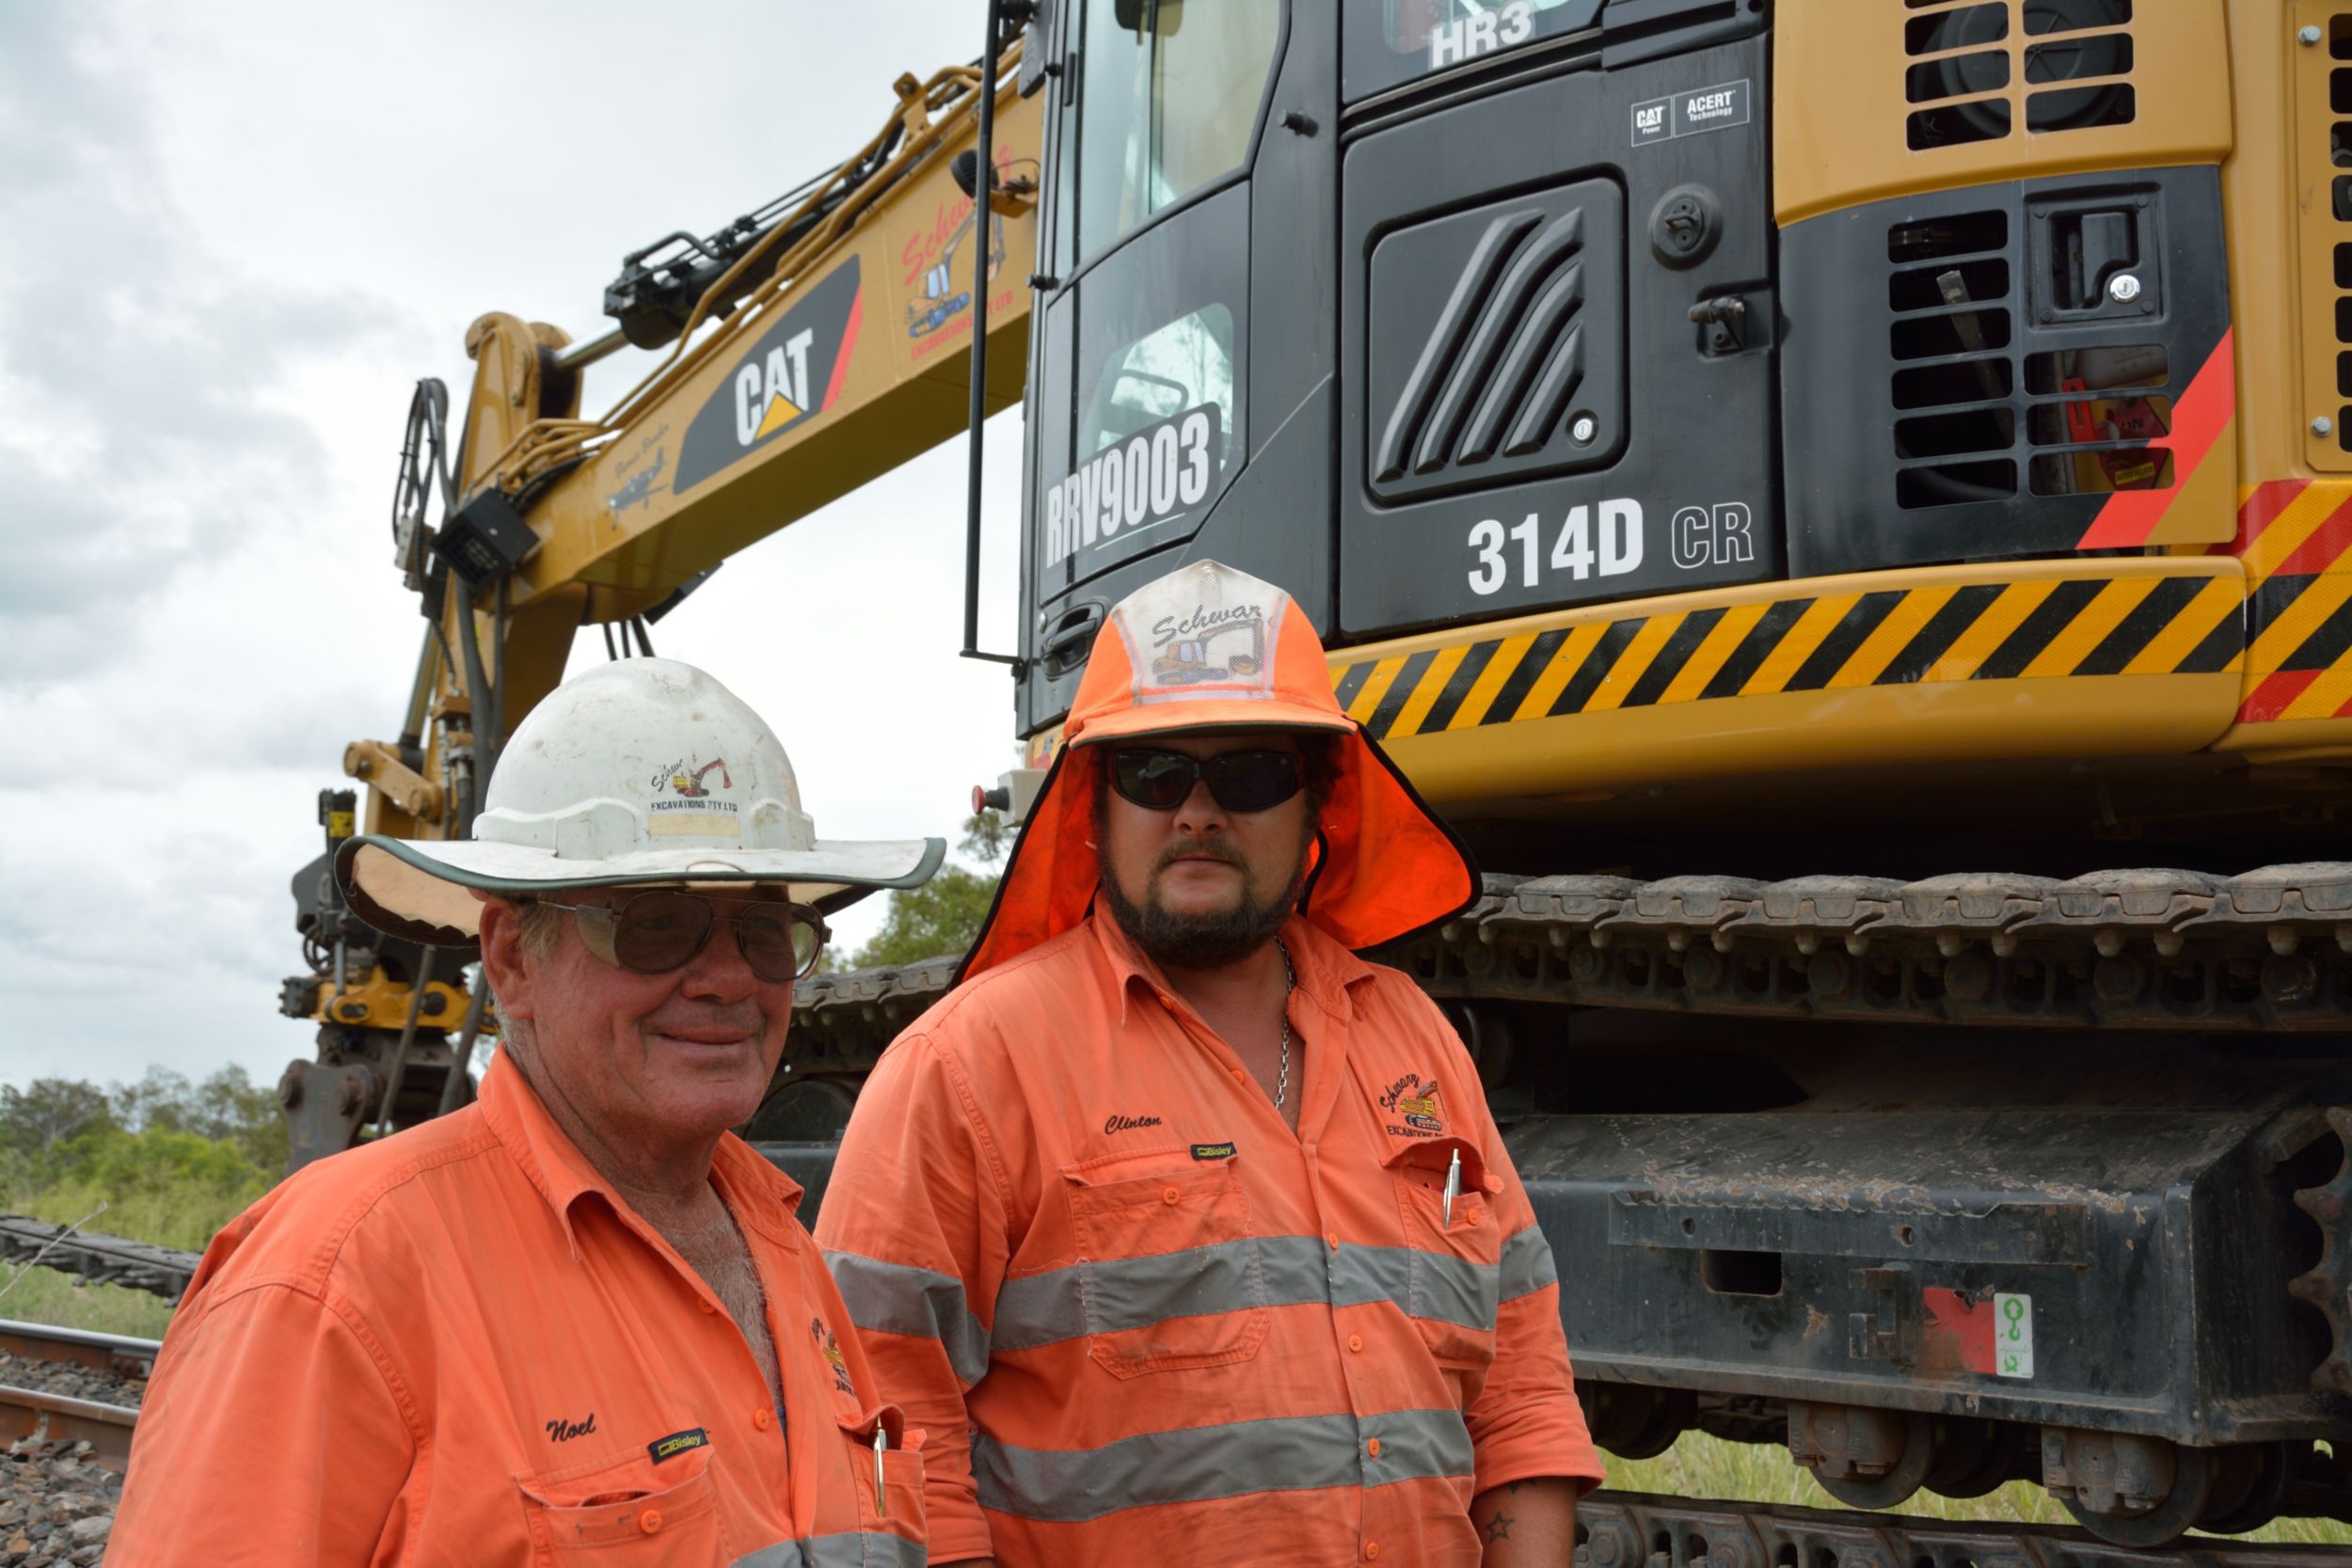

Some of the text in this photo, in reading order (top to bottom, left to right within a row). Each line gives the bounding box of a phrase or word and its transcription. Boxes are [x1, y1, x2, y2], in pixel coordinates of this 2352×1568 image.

[1432, 2, 1533, 69] HR3
[1687, 91, 1732, 115] ACERT
[1689, 106, 1733, 122] Technology
[1636, 105, 1662, 129] CAT
[1642, 126, 1661, 135] Power
[736, 326, 813, 446] CAT
[1046, 411, 1210, 569] RRV9003
[1468, 498, 1754, 595] 314D CR
[651, 800, 706, 812] EXCAVATIONS
[1104, 1115, 1162, 1135] Clinton
[1205, 1146, 1232, 1157] Bisley
[546, 1413, 596, 1443] Noel
[669, 1435, 701, 1452] Bisley
